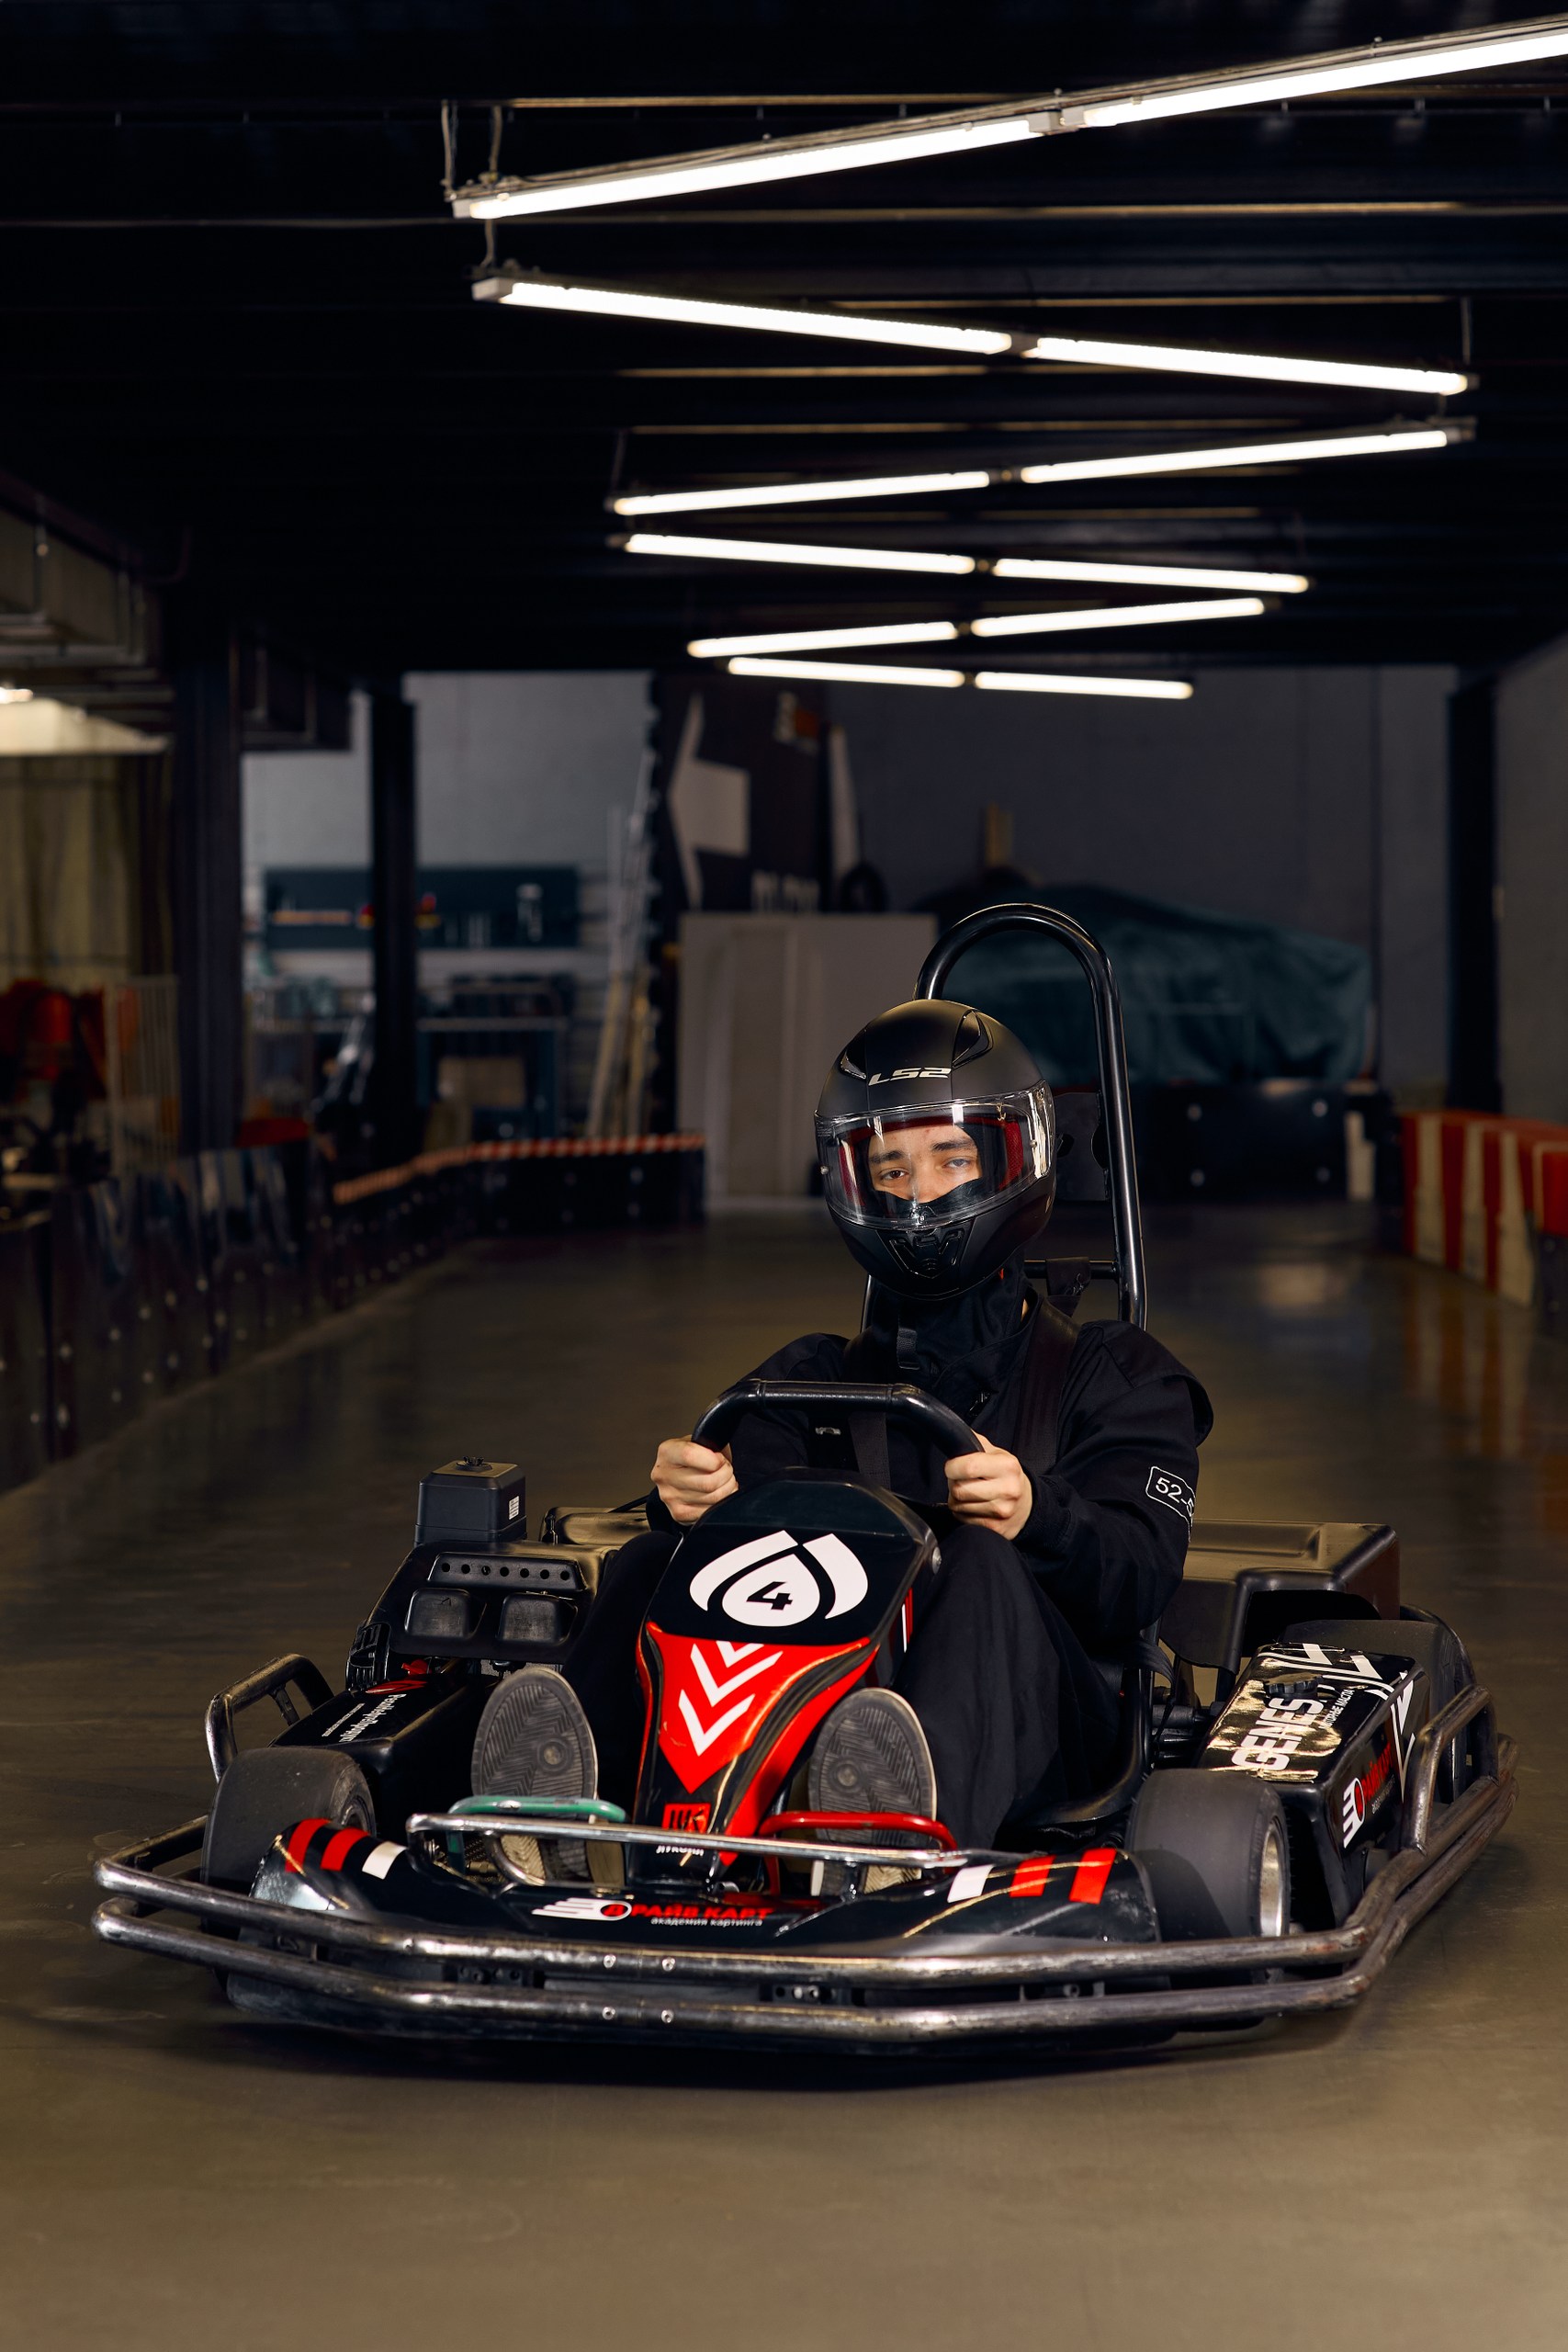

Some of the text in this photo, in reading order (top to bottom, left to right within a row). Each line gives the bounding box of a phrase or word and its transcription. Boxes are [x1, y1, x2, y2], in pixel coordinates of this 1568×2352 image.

[868, 1067, 953, 1086] LS2
[746, 1580, 794, 1611] 4
[602, 1903, 774, 1921] ДРАЙВ КАРТ
[650, 1917, 763, 1928] академия картинга
